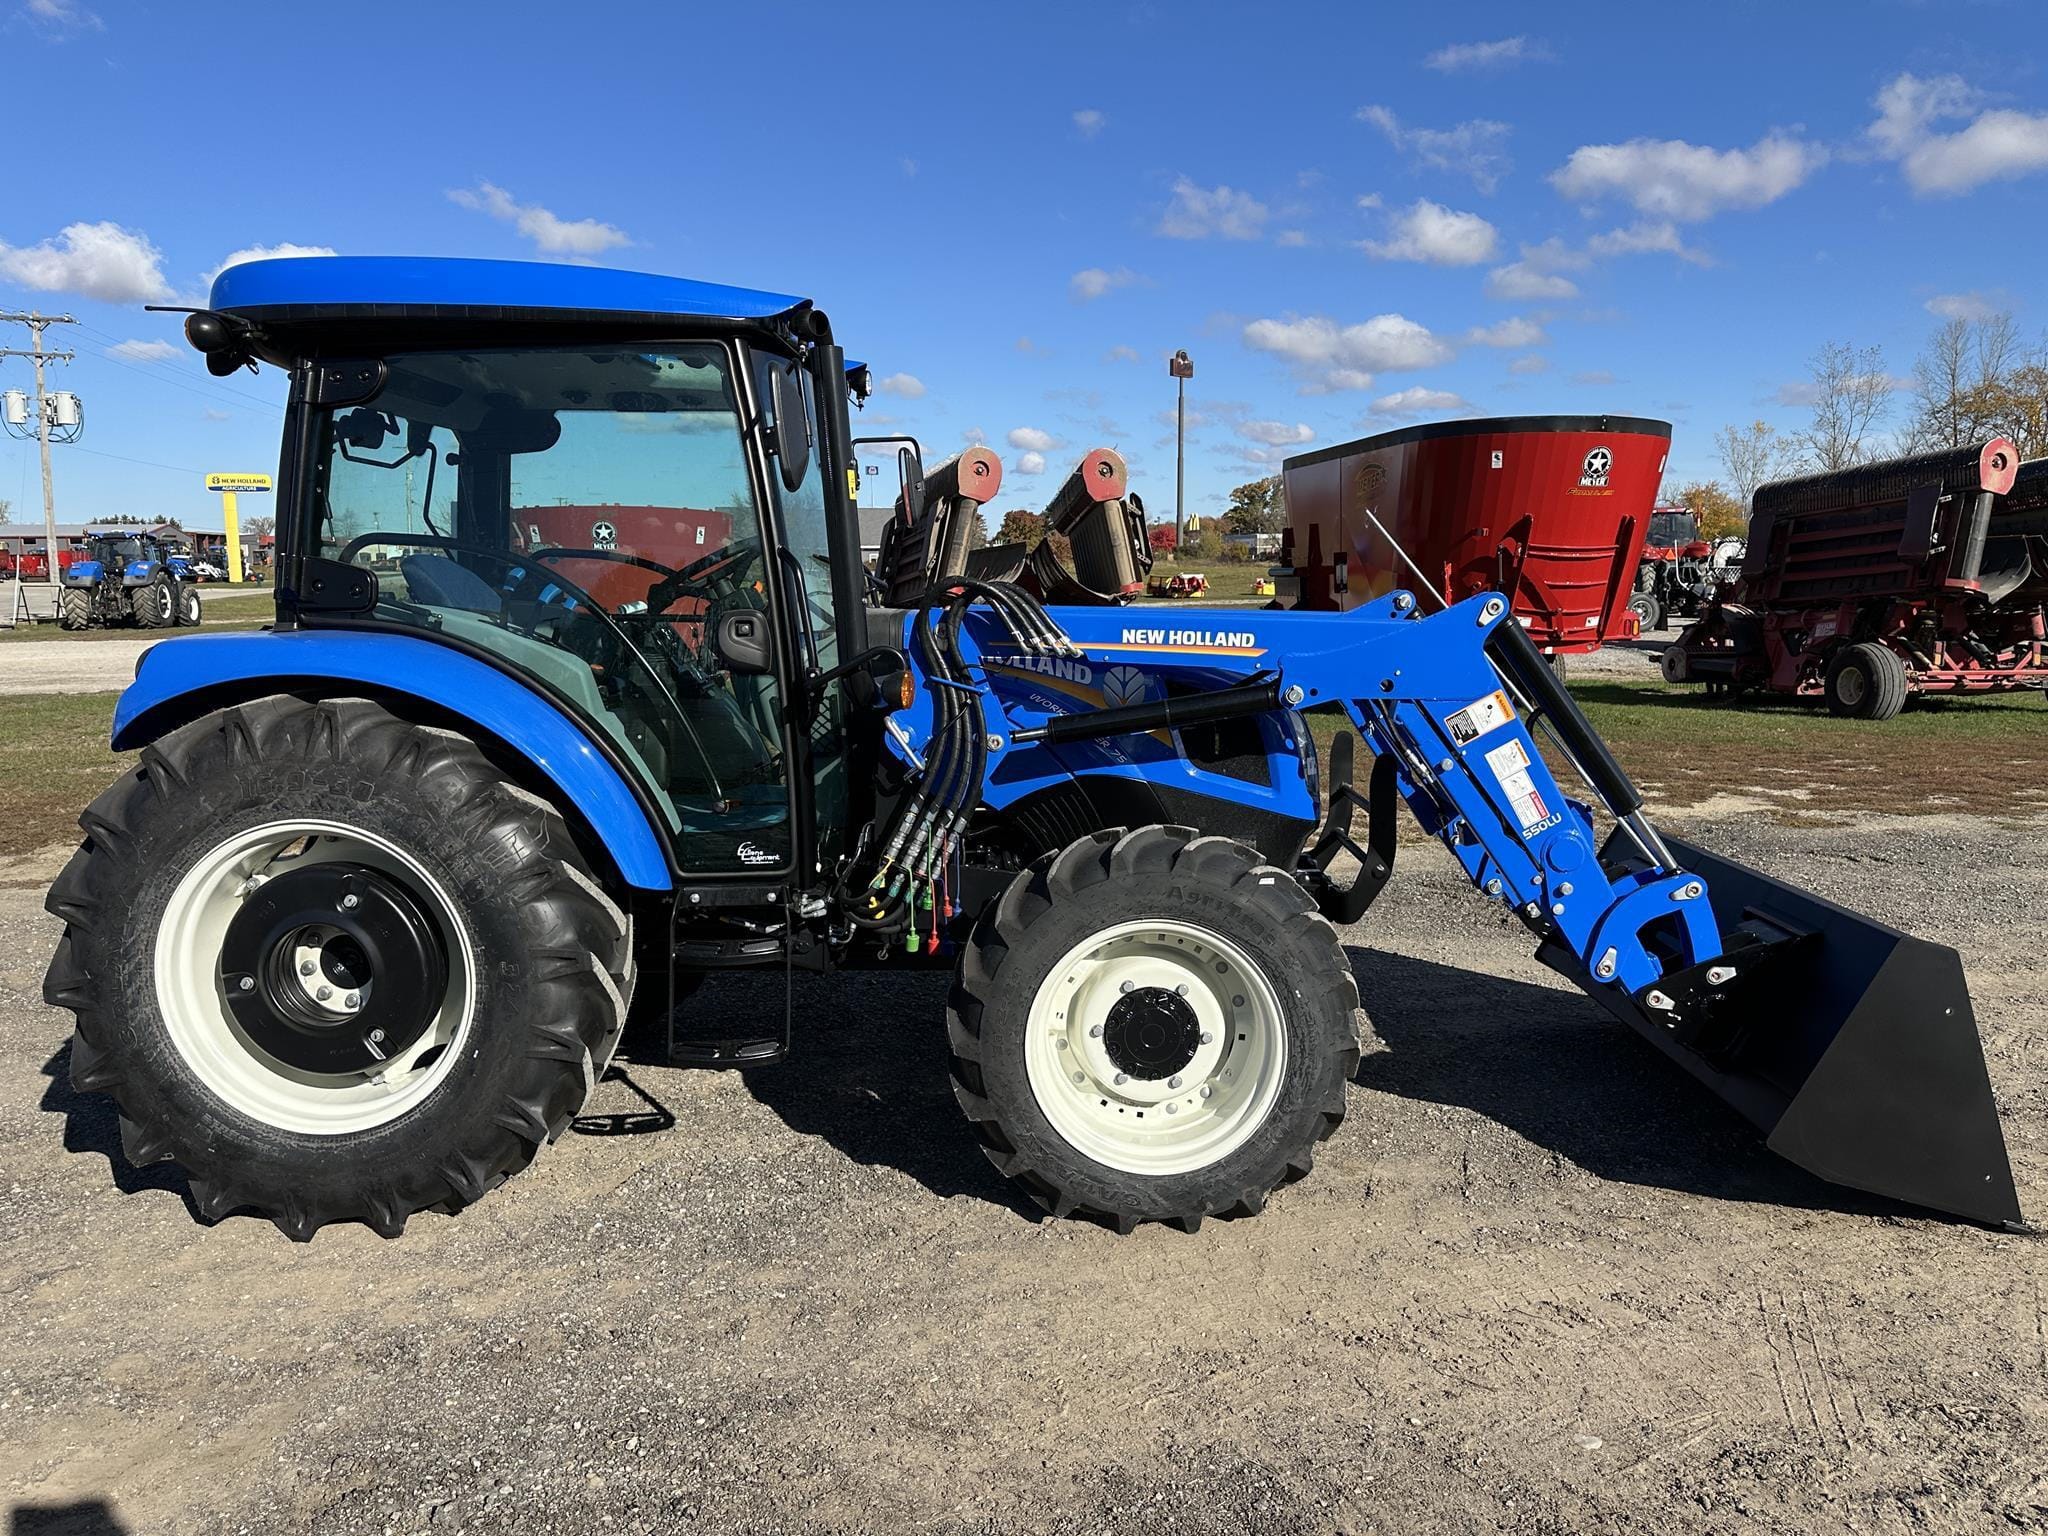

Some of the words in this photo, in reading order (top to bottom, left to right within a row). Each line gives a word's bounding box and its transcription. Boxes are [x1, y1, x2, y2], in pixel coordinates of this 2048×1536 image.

[1580, 477, 1607, 486] MEYER
[1121, 629, 1165, 644] NEW
[1168, 630, 1256, 647] HOLLAND
[1110, 748, 1128, 763] 75
[1522, 813, 1562, 840] 550LU
